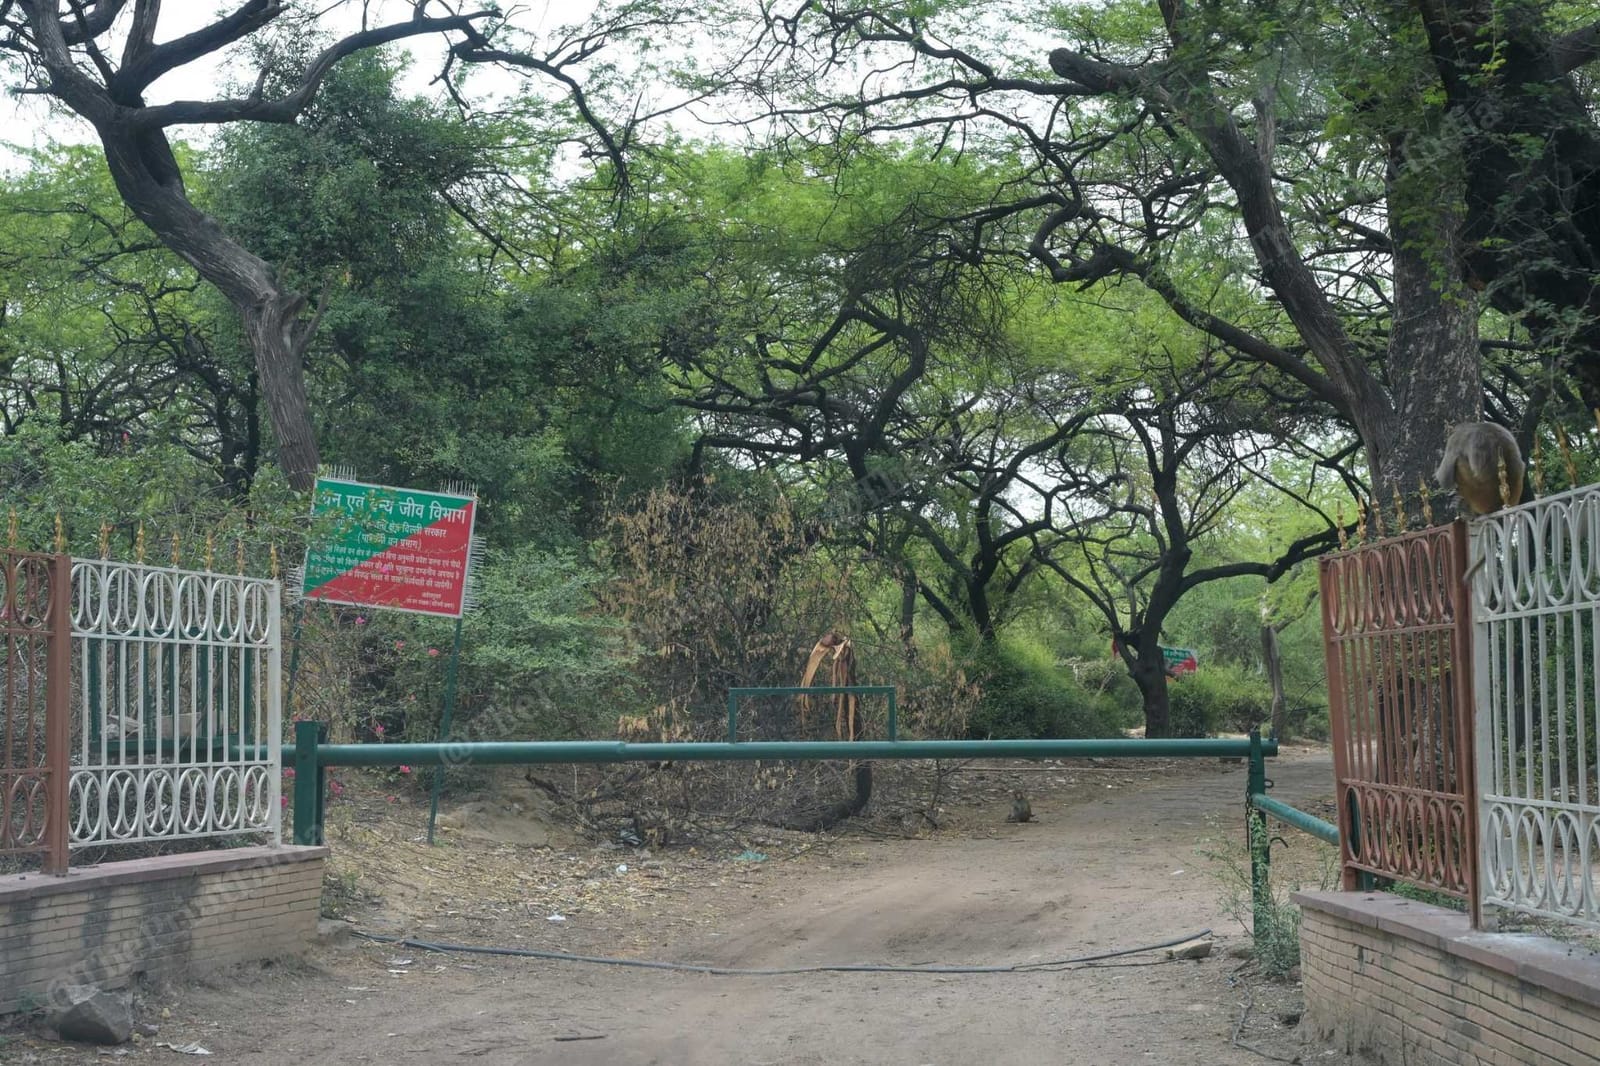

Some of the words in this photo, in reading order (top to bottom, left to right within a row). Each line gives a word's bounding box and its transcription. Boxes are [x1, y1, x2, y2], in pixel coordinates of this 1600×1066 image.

[399, 495, 425, 518] जीव
[430, 500, 467, 524] विभाग
[403, 522, 423, 534] दिल्ली
[425, 526, 446, 538] सरकार
[388, 537, 397, 546] वन
